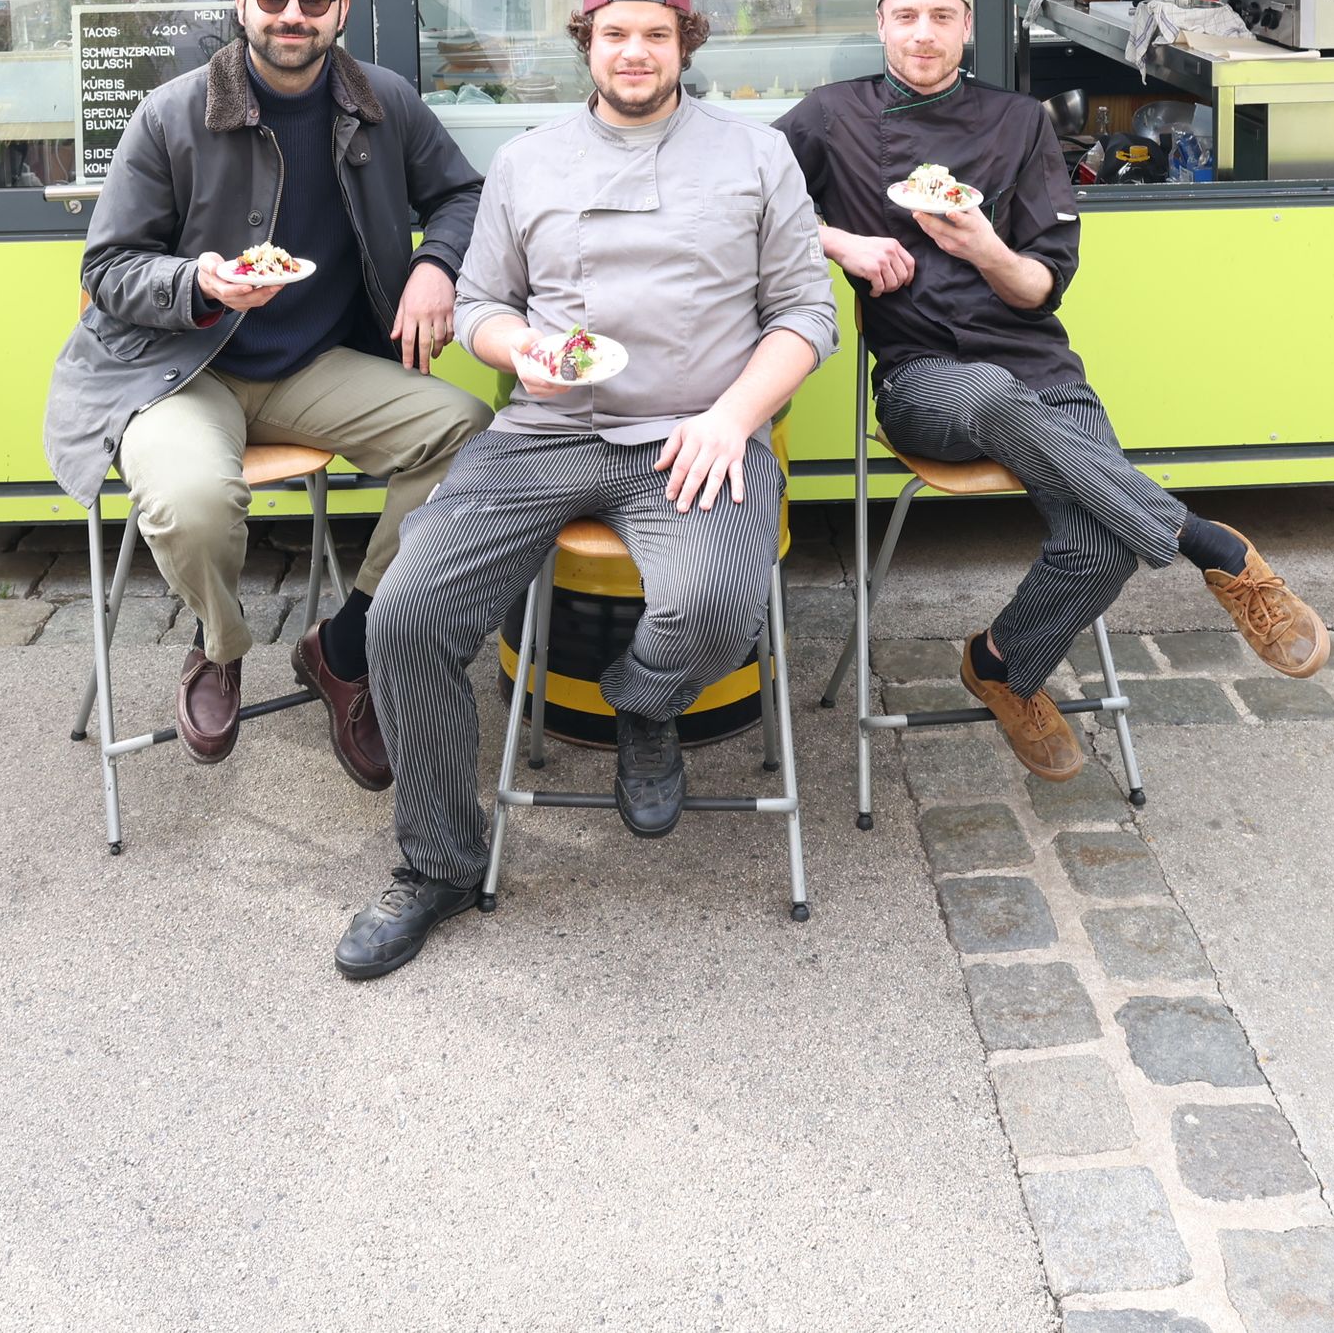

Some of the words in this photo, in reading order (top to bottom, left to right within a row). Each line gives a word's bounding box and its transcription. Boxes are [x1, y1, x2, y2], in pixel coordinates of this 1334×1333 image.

[195, 10, 225, 21] MENU
[83, 27, 121, 38] TACOS:
[82, 46, 175, 58] SCHWEINZBRATEN
[82, 58, 133, 70] GULASCH
